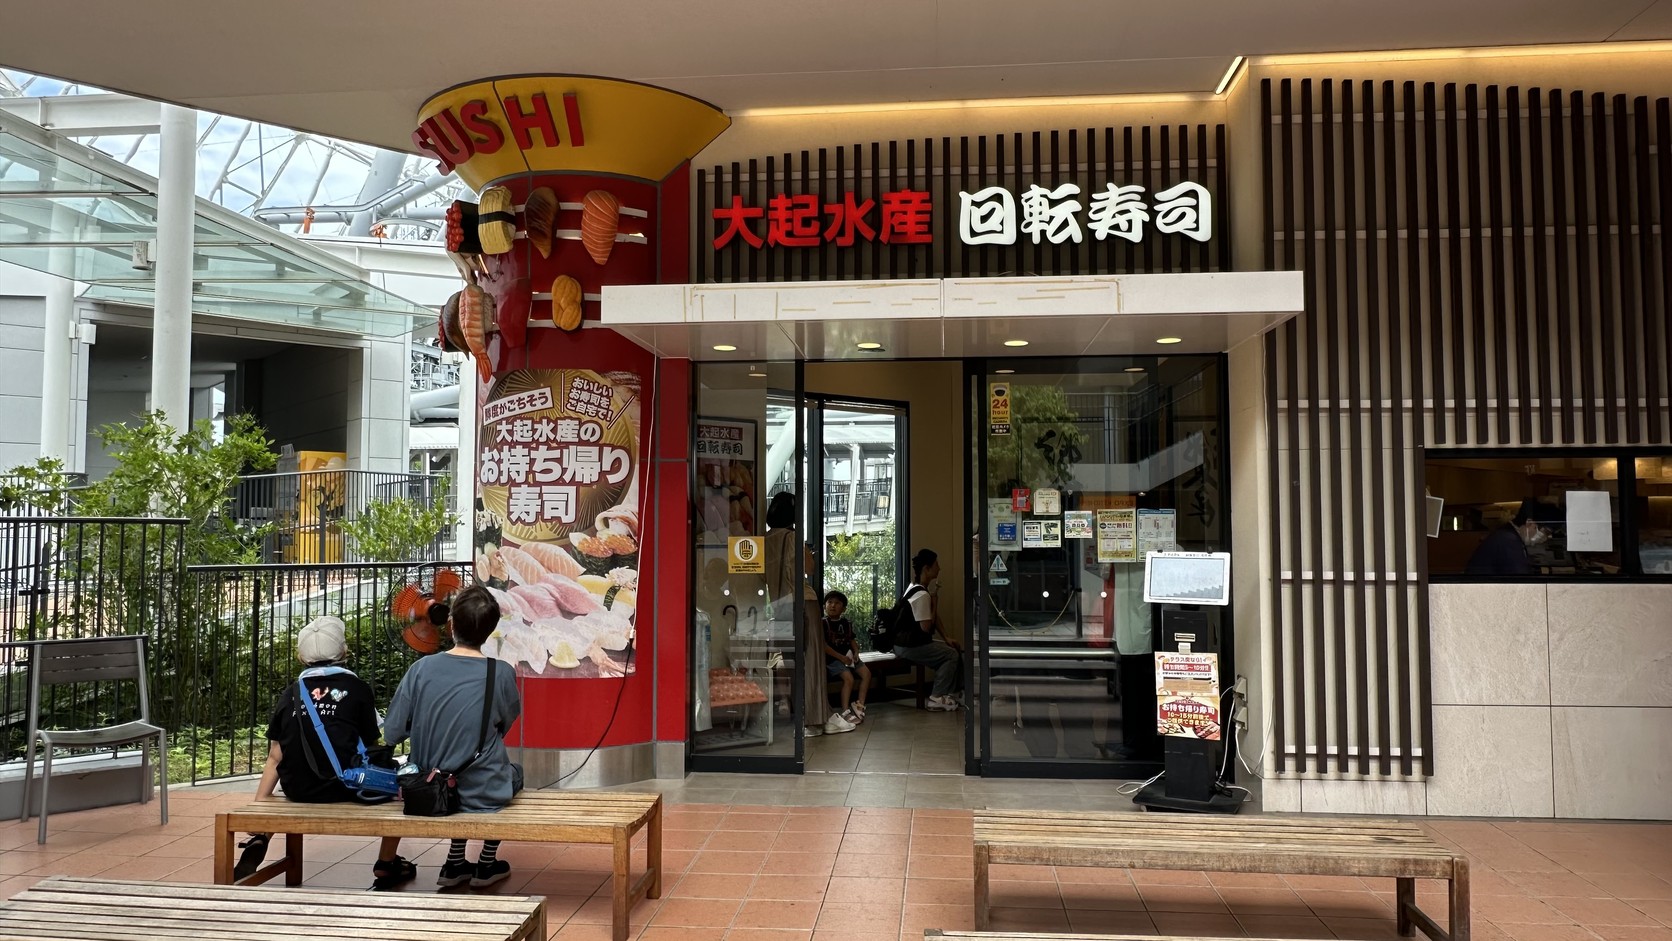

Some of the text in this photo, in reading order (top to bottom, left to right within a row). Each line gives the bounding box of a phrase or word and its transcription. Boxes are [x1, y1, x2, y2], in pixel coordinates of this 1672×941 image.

[712, 181, 1213, 250] 大起水産 回転寿司
[569, 388, 610, 408] お寿司を
[572, 377, 614, 397] おいしい
[484, 392, 549, 422] 鮮度がごちそう
[992, 398, 1008, 409] 24
[496, 419, 602, 443] 大起水産の
[480, 445, 630, 484] お持ち帰り
[510, 485, 576, 523] 寿司
[1161, 703, 1215, 715] お持ち帰り寿司
